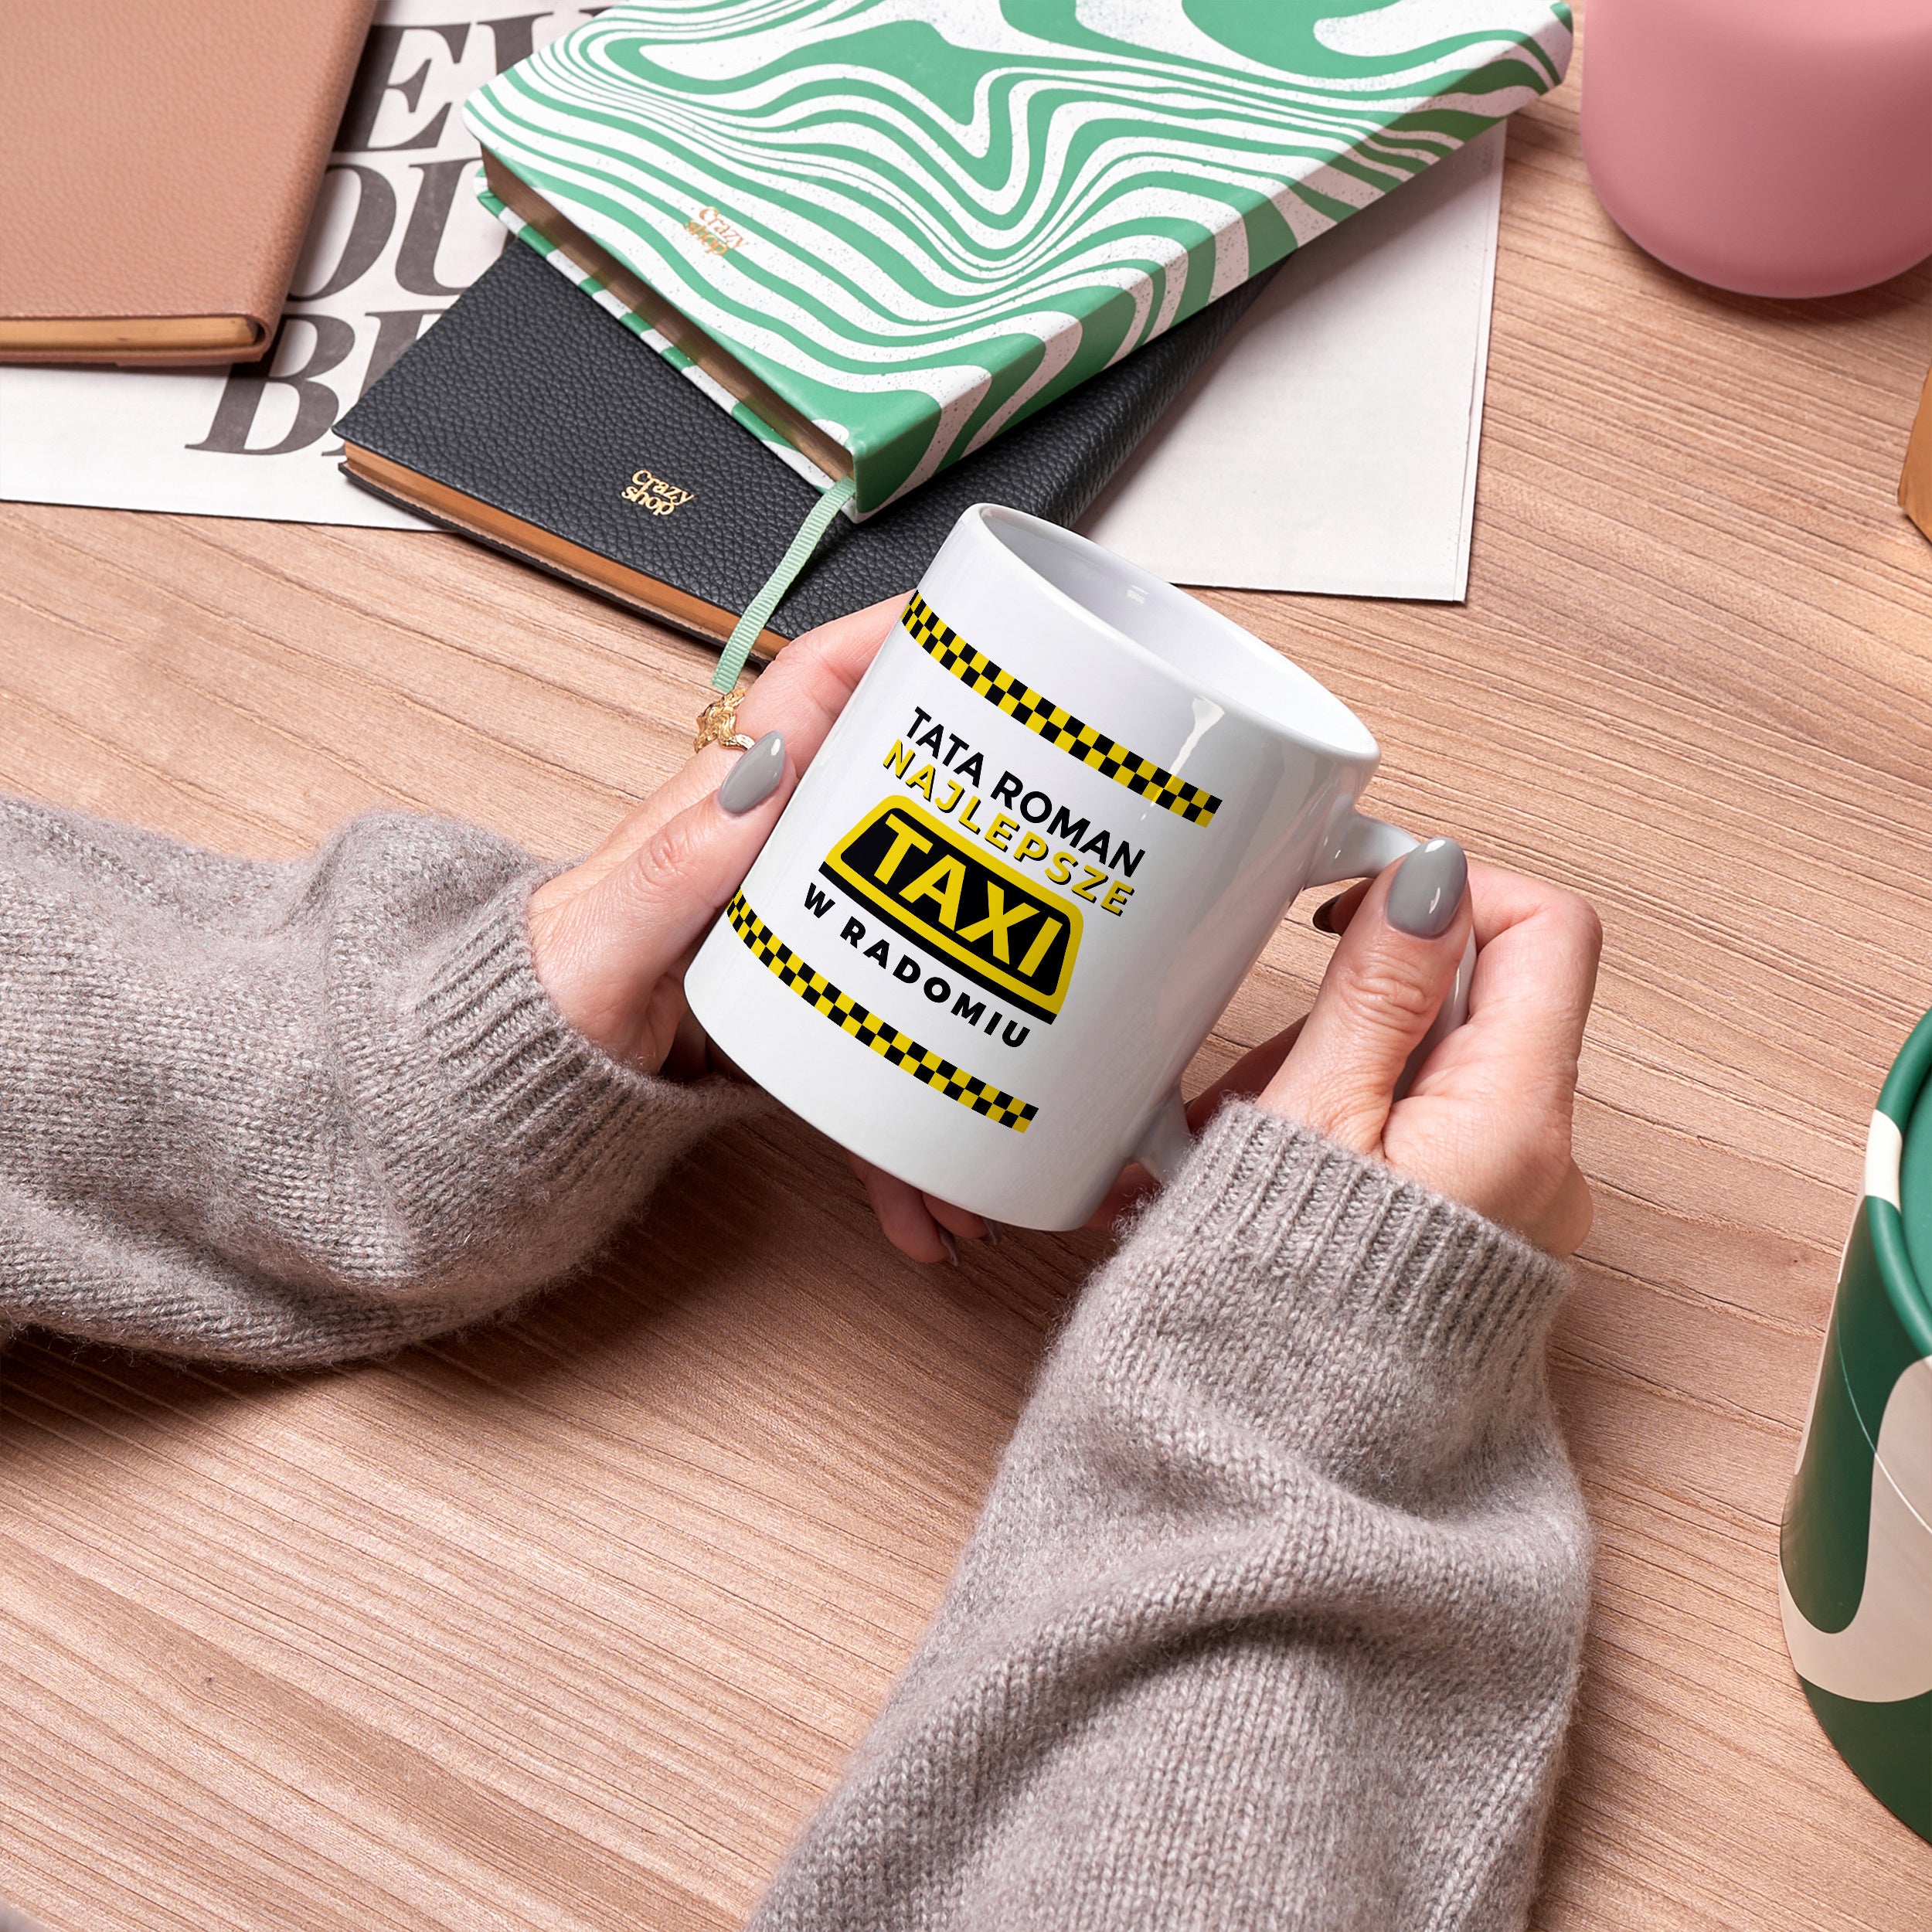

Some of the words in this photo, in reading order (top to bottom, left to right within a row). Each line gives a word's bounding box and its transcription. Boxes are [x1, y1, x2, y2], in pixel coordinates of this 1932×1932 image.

[684, 220, 729, 255] shop
[621, 485, 675, 516] shop
[883, 739, 1135, 917] NAJLEPSZE
[906, 706, 985, 787] TATA
[991, 770, 1146, 878] ROMAN
[803, 883, 836, 919] W
[840, 917, 1031, 1049] RADOMIU
[873, 813, 1063, 977] TAXI
